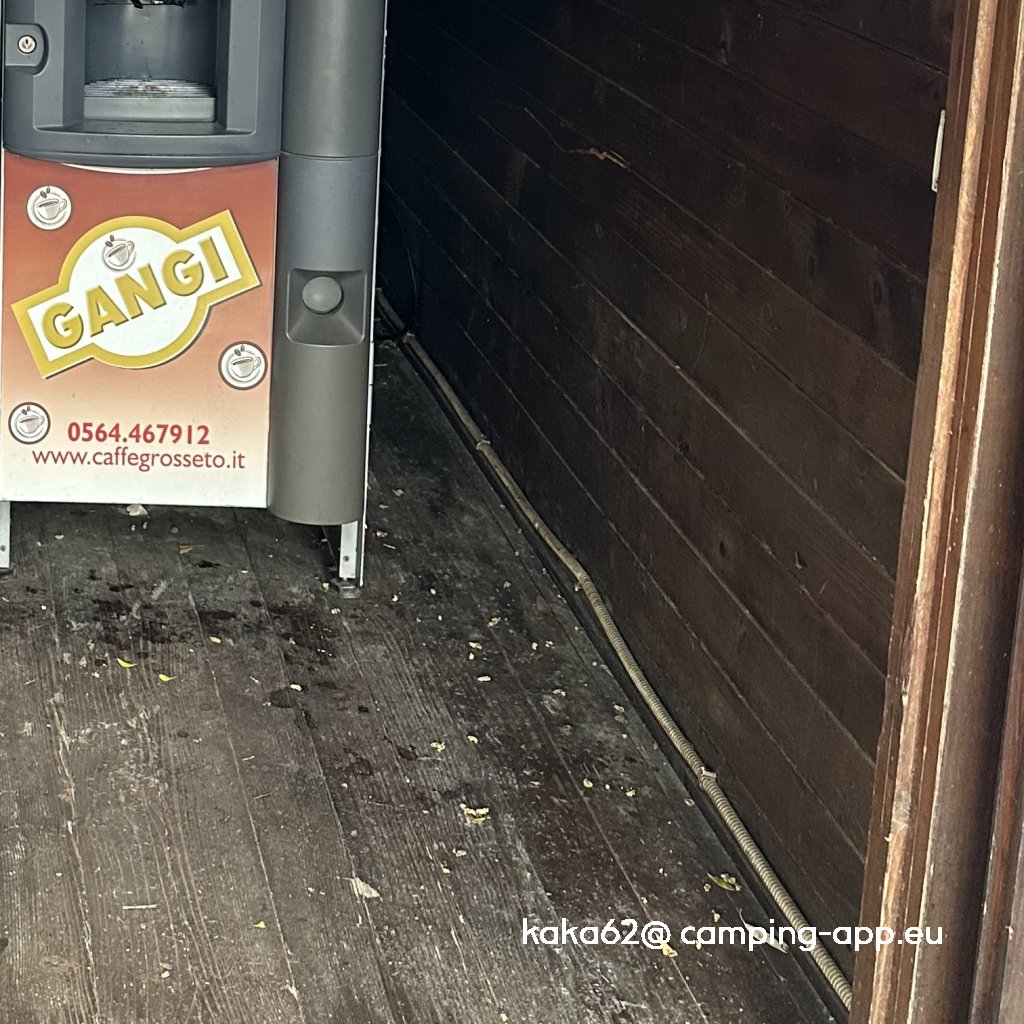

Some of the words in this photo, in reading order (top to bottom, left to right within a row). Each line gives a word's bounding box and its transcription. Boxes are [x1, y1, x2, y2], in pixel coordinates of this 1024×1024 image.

[41, 236, 229, 350] GANGI
[67, 422, 210, 445] 0564.467912
[32, 447, 246, 472] www.caffegrosseto.it
